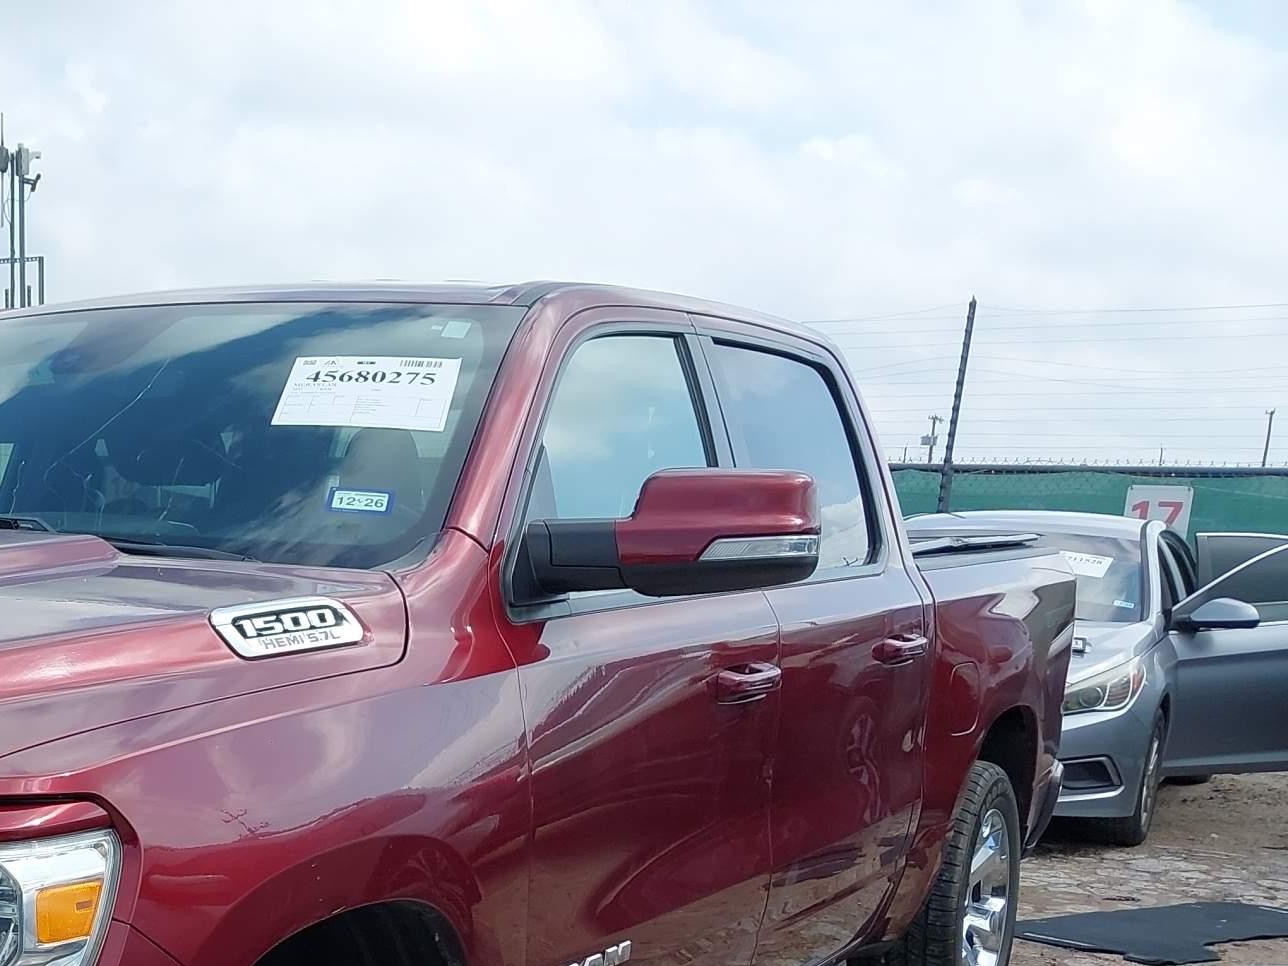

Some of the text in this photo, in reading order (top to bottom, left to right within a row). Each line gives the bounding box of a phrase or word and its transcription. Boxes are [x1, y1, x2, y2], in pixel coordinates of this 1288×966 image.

[306, 370, 437, 385] 45680275
[1131, 501, 1184, 527] 17
[236, 608, 336, 637] 1500
[263, 631, 340, 649] HEMI 5.7L
